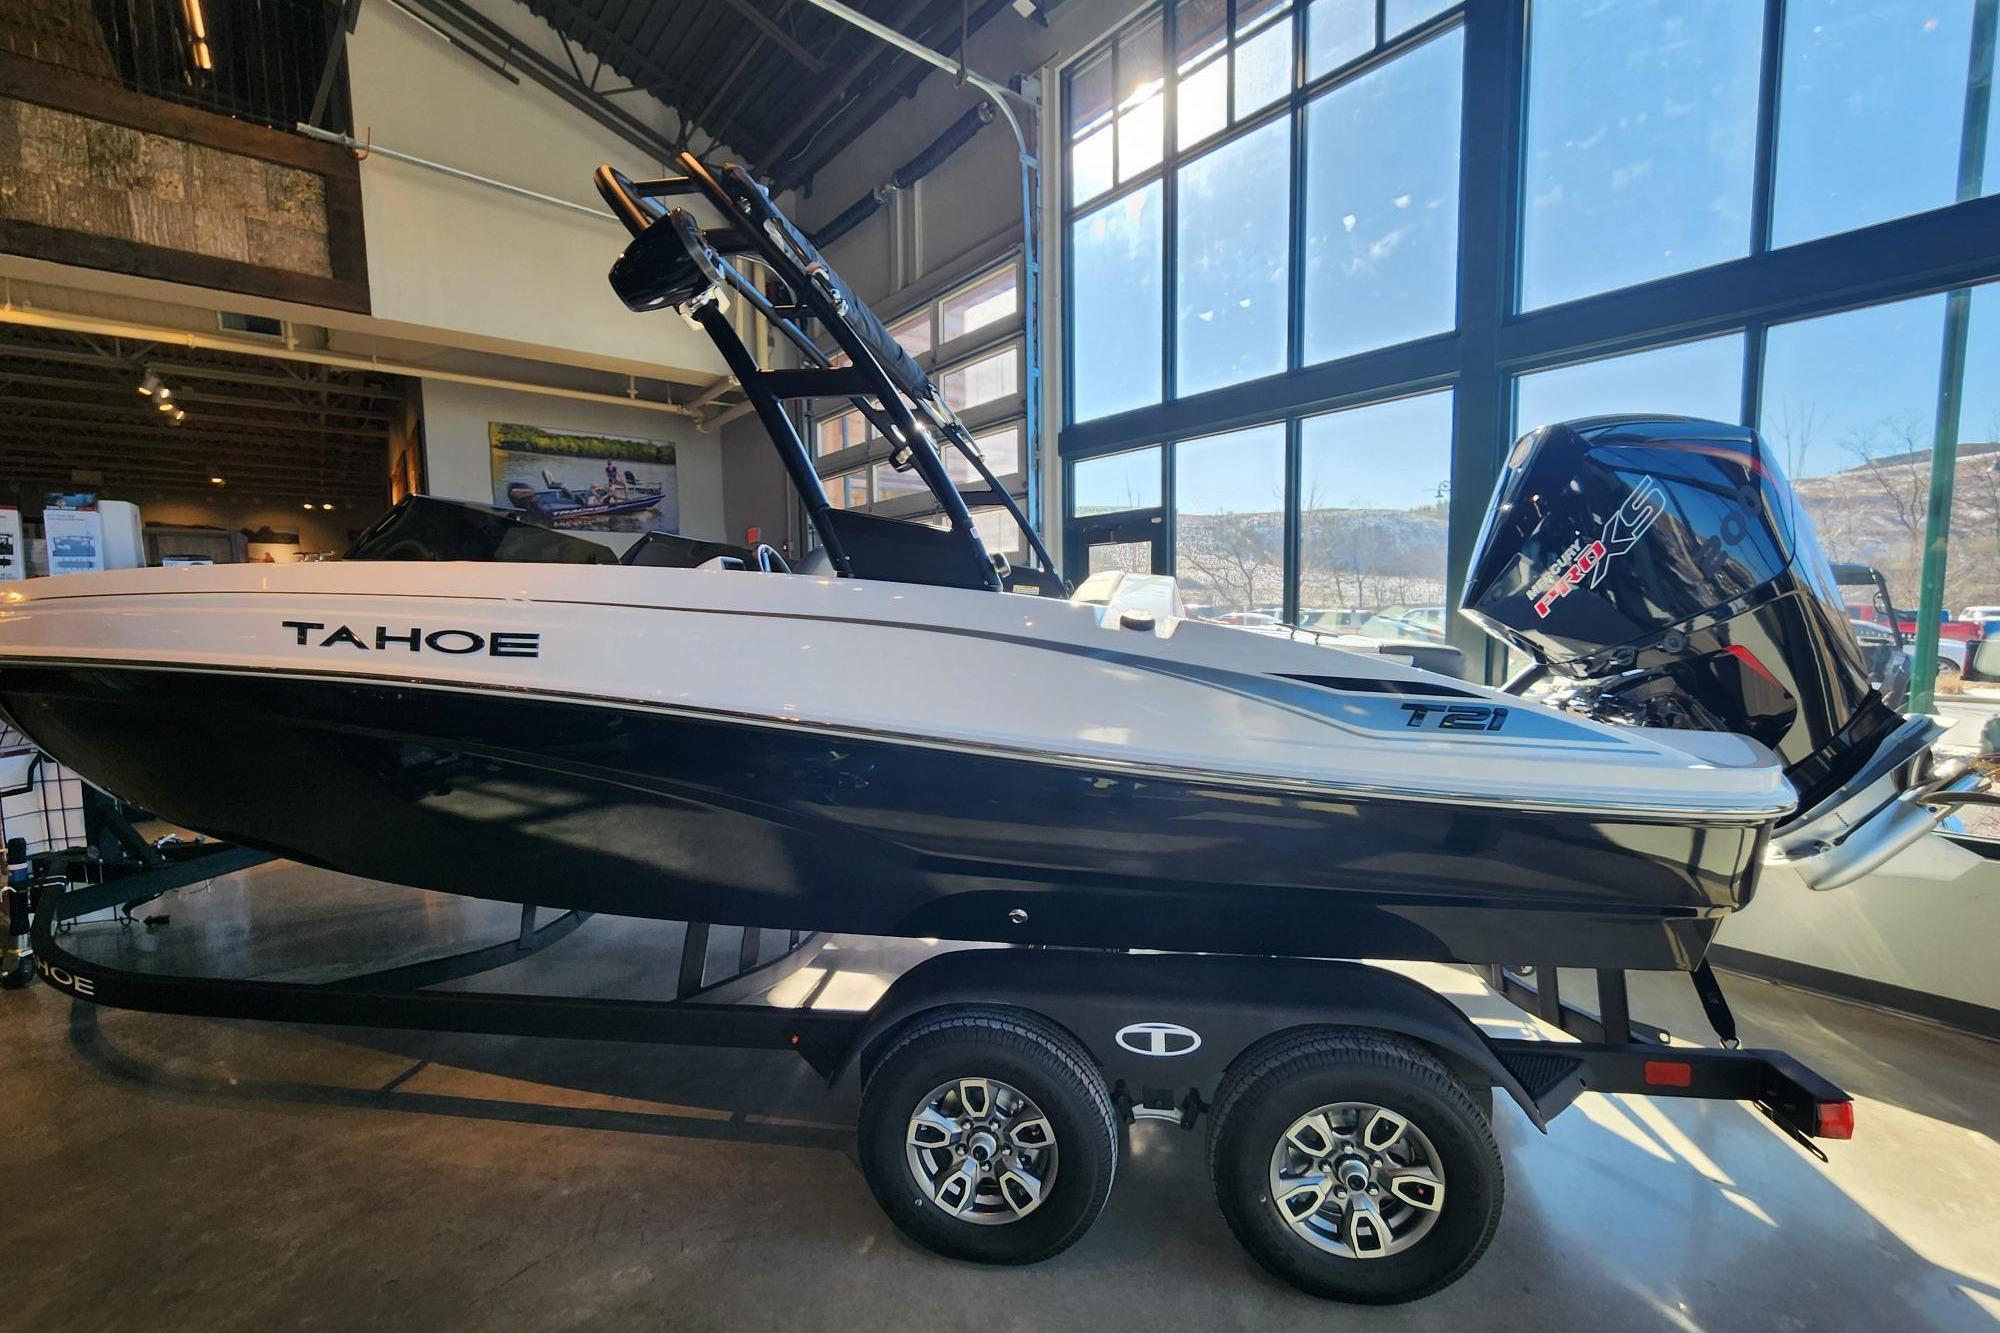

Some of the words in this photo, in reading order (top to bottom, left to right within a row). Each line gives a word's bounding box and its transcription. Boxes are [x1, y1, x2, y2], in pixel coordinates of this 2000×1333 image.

[1525, 538, 1582, 601] MERCURY
[282, 621, 540, 658] TAHOE
[1400, 703, 1509, 731] T21
